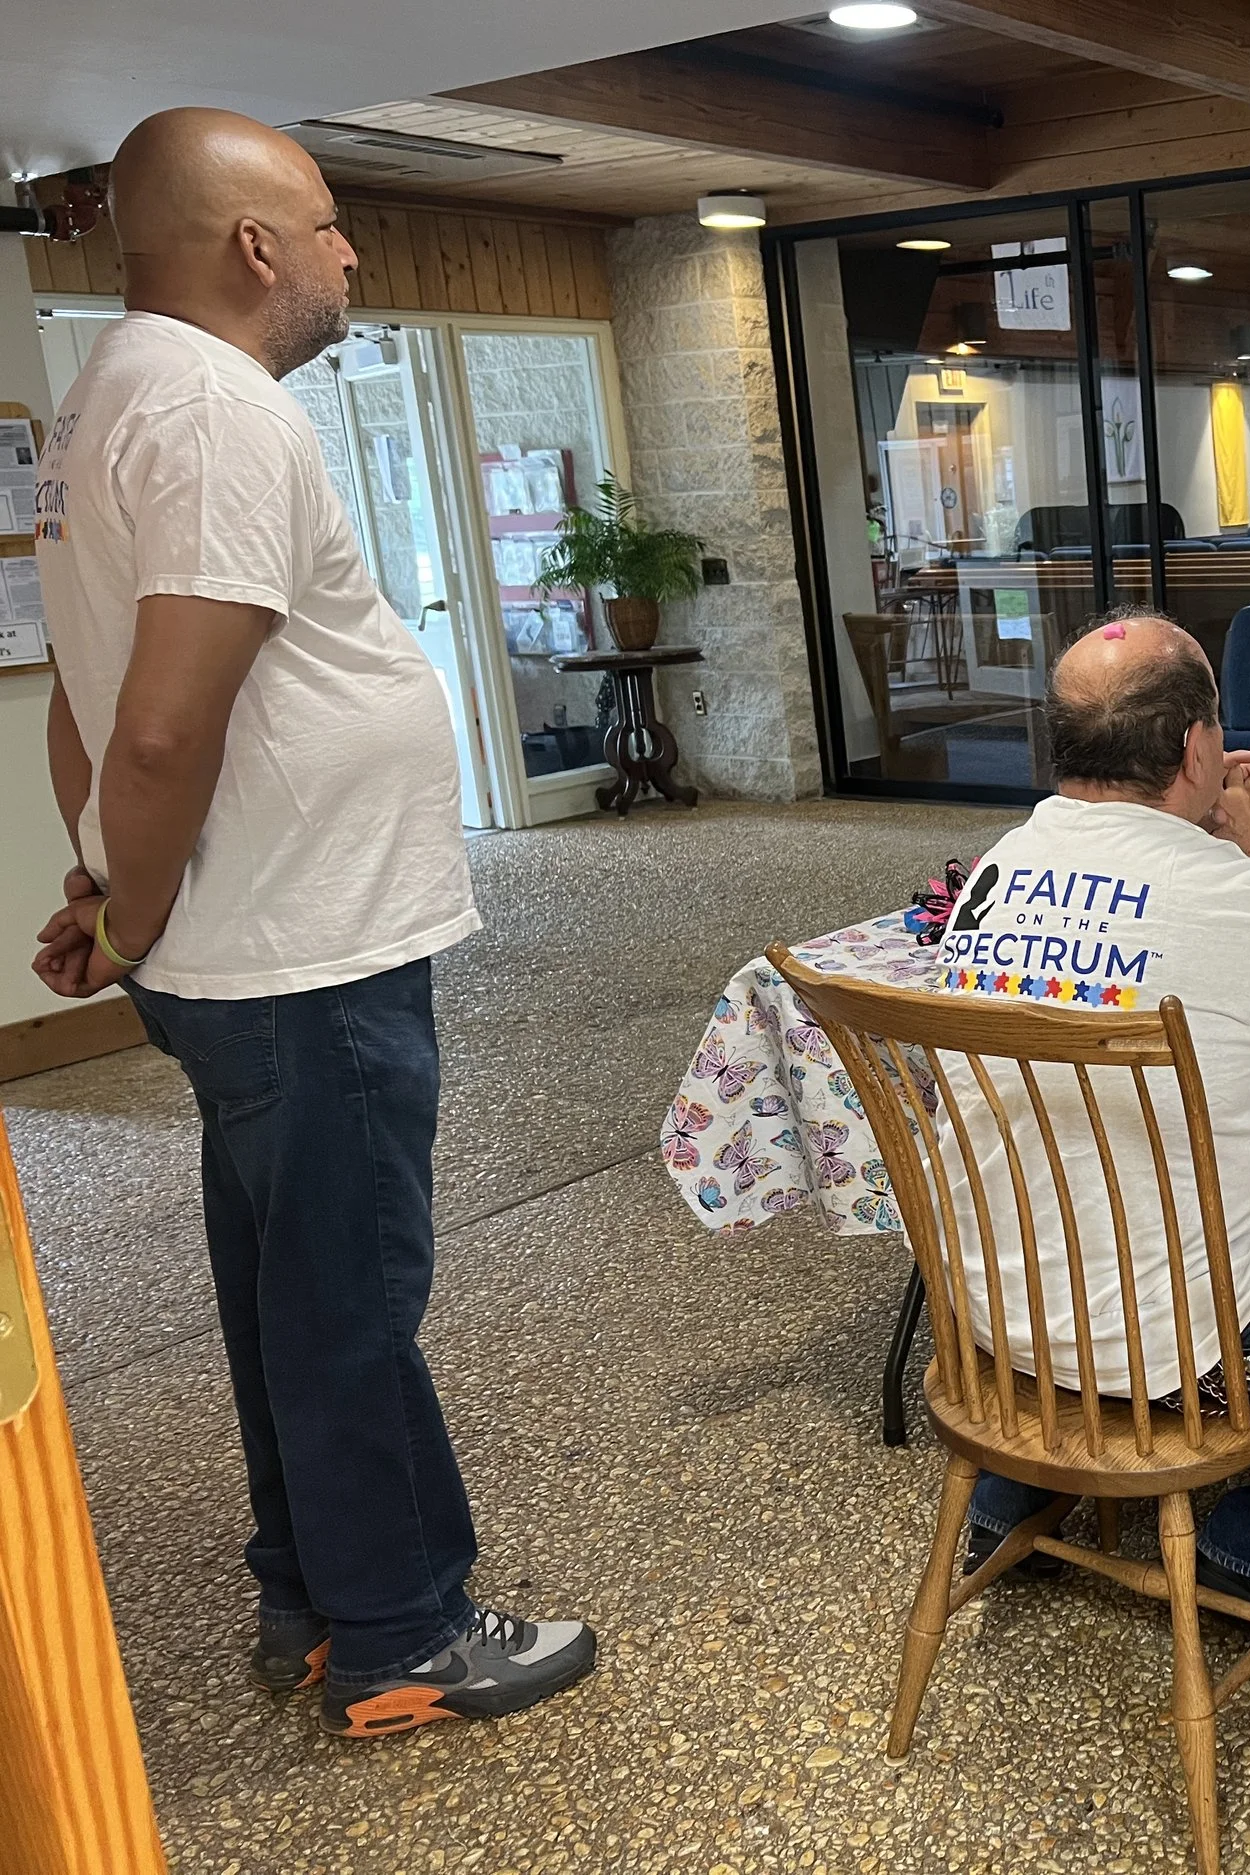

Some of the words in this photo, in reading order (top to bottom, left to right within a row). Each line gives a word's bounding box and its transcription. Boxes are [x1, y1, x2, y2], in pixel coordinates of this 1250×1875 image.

[999, 271, 1054, 311] Life
[1003, 869, 1150, 919] FAITH
[1016, 913, 1043, 925] ON
[1063, 916, 1109, 933] THE
[943, 932, 1149, 983] SPECTRUM
